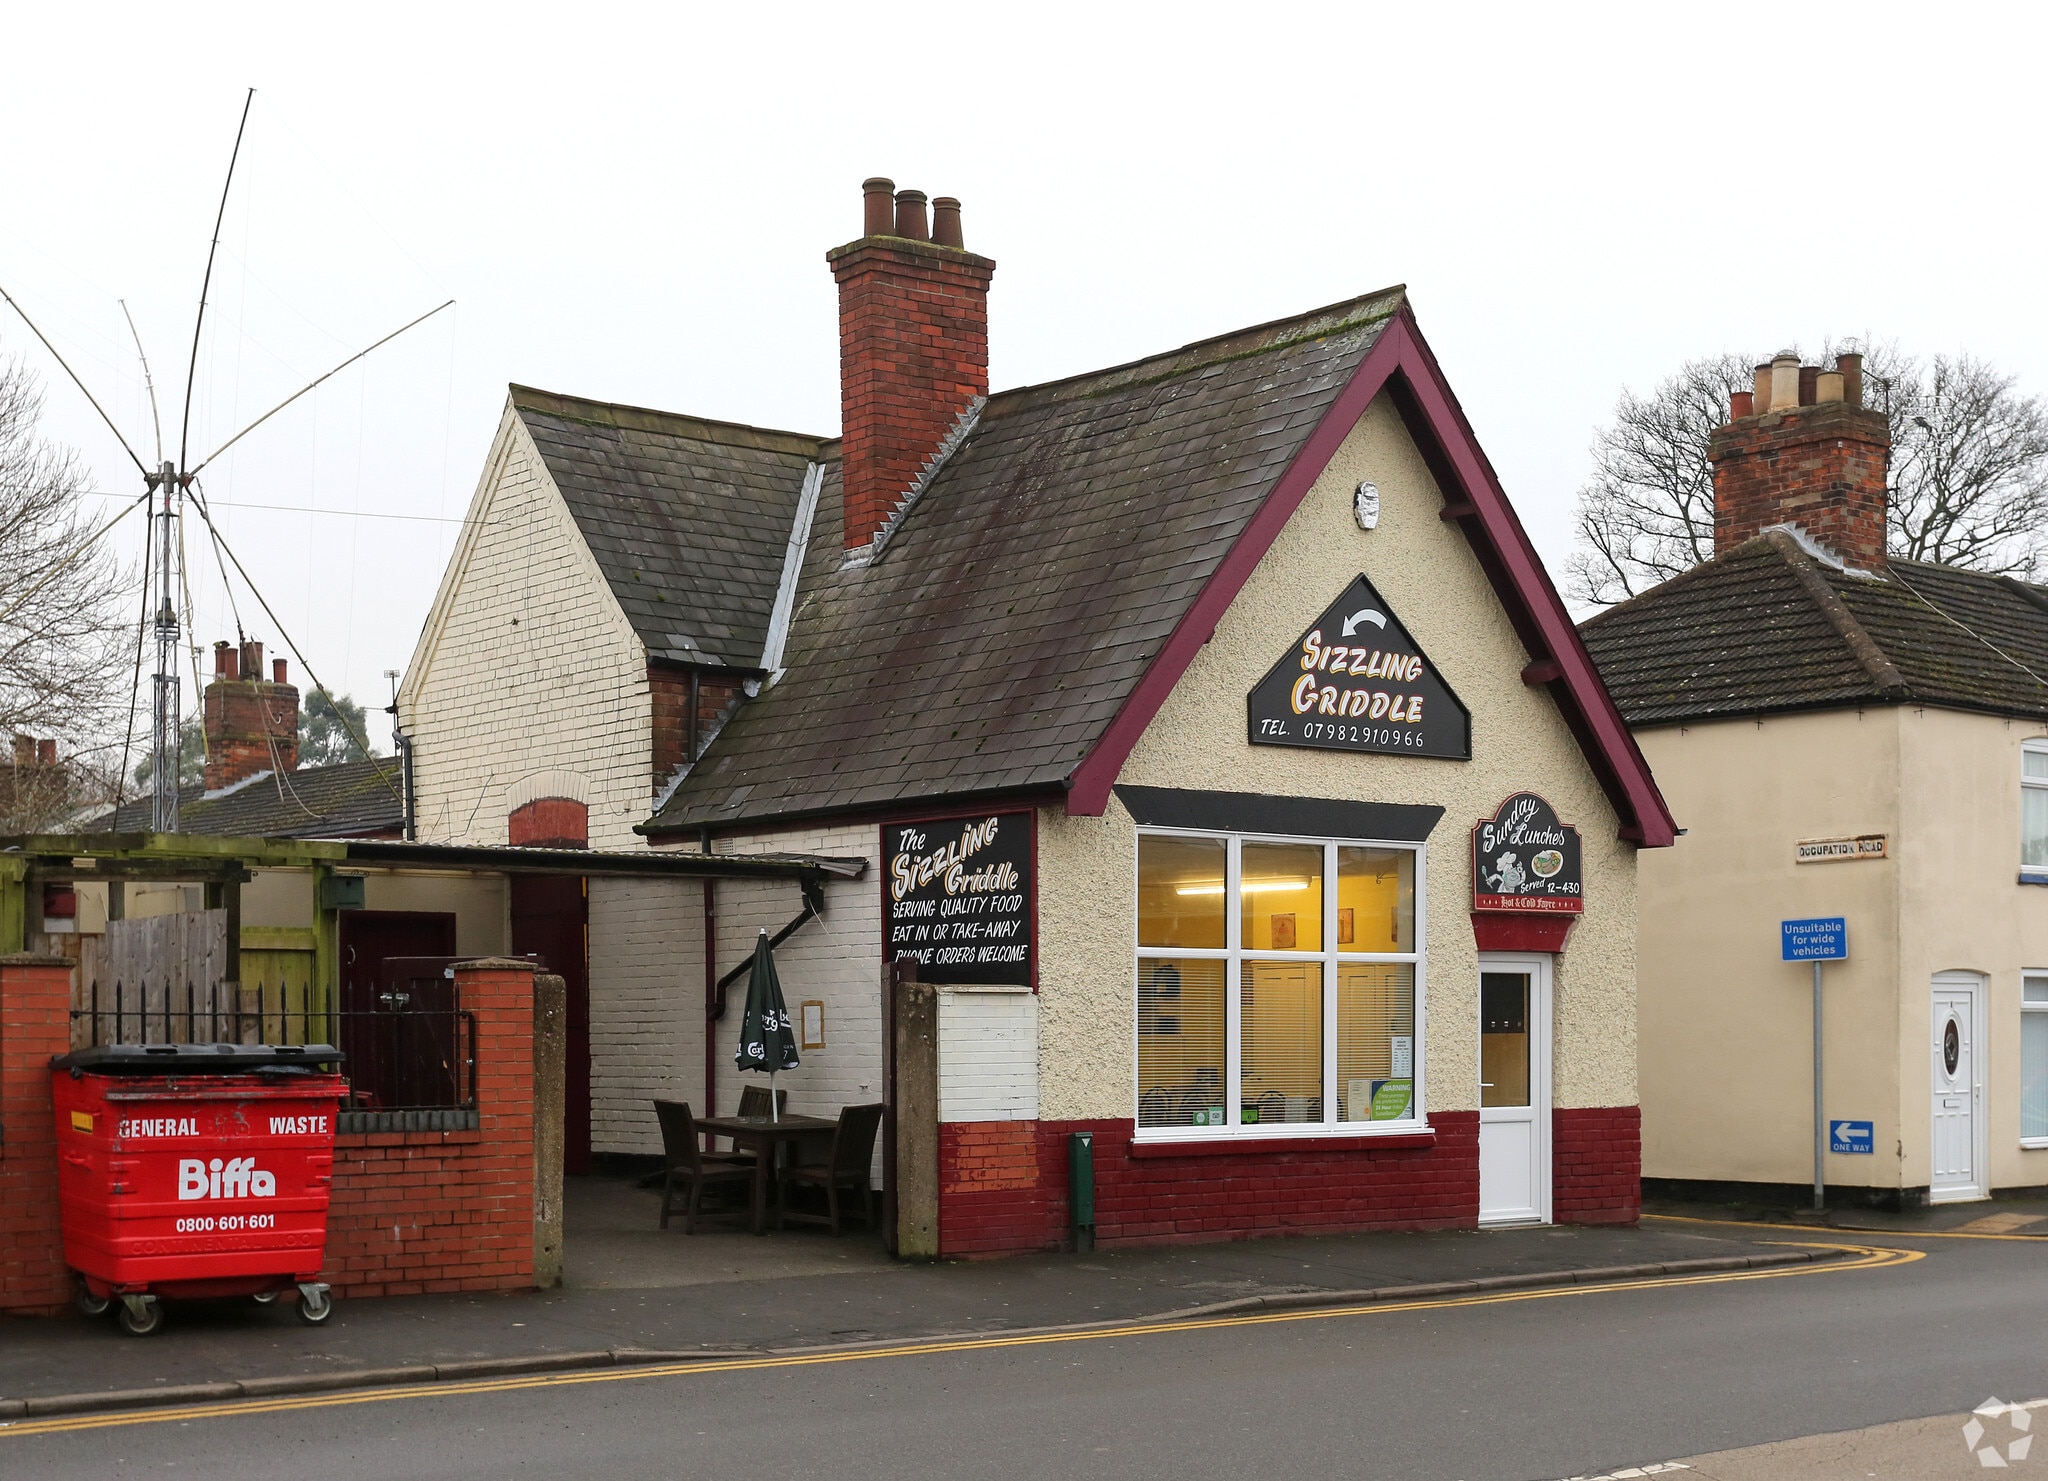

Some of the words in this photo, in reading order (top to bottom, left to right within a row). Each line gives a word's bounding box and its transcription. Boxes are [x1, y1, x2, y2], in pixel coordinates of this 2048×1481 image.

[1301, 629, 1423, 681] SIZZLING
[1290, 673, 1424, 723] GRIDDLE
[1260, 719, 1290, 736] TEL.
[1303, 722, 1424, 747] 07982910966
[1482, 799, 1540, 853] Sunday
[1510, 822, 1565, 846] Lunches
[900, 829, 926, 851] The
[1800, 844, 1855, 856] OCCUPATION
[1858, 842, 1883, 852] ROAD
[944, 861, 1019, 895] Griddle
[893, 900, 936, 918] SERVING
[940, 897, 988, 918] QUALITY
[990, 895, 1022, 913] FOOD
[1501, 896, 1515, 909] Hot
[1536, 897, 1556, 910] Fayre
[892, 925, 915, 942] EAT
[915, 924, 930, 940] IN
[933, 924, 949, 940] OR
[951, 920, 1021, 939] TAKE-AWAY
[1784, 922, 1841, 934] Unsuitable
[1792, 935, 1807, 945] for
[1810, 934, 1835, 944] wide
[936, 946, 976, 964] ORDERS
[977, 944, 1028, 963] WELCOME
[1792, 946, 1836, 956] vehicles
[1383, 1084, 1411, 1092] WARNING
[119, 1118, 199, 1138] GENERAL
[269, 1116, 328, 1135] WASTE
[1833, 1143, 1850, 1151] ONE
[1852, 1144, 1870, 1152] WAY
[178, 1157, 276, 1200] Biffa
